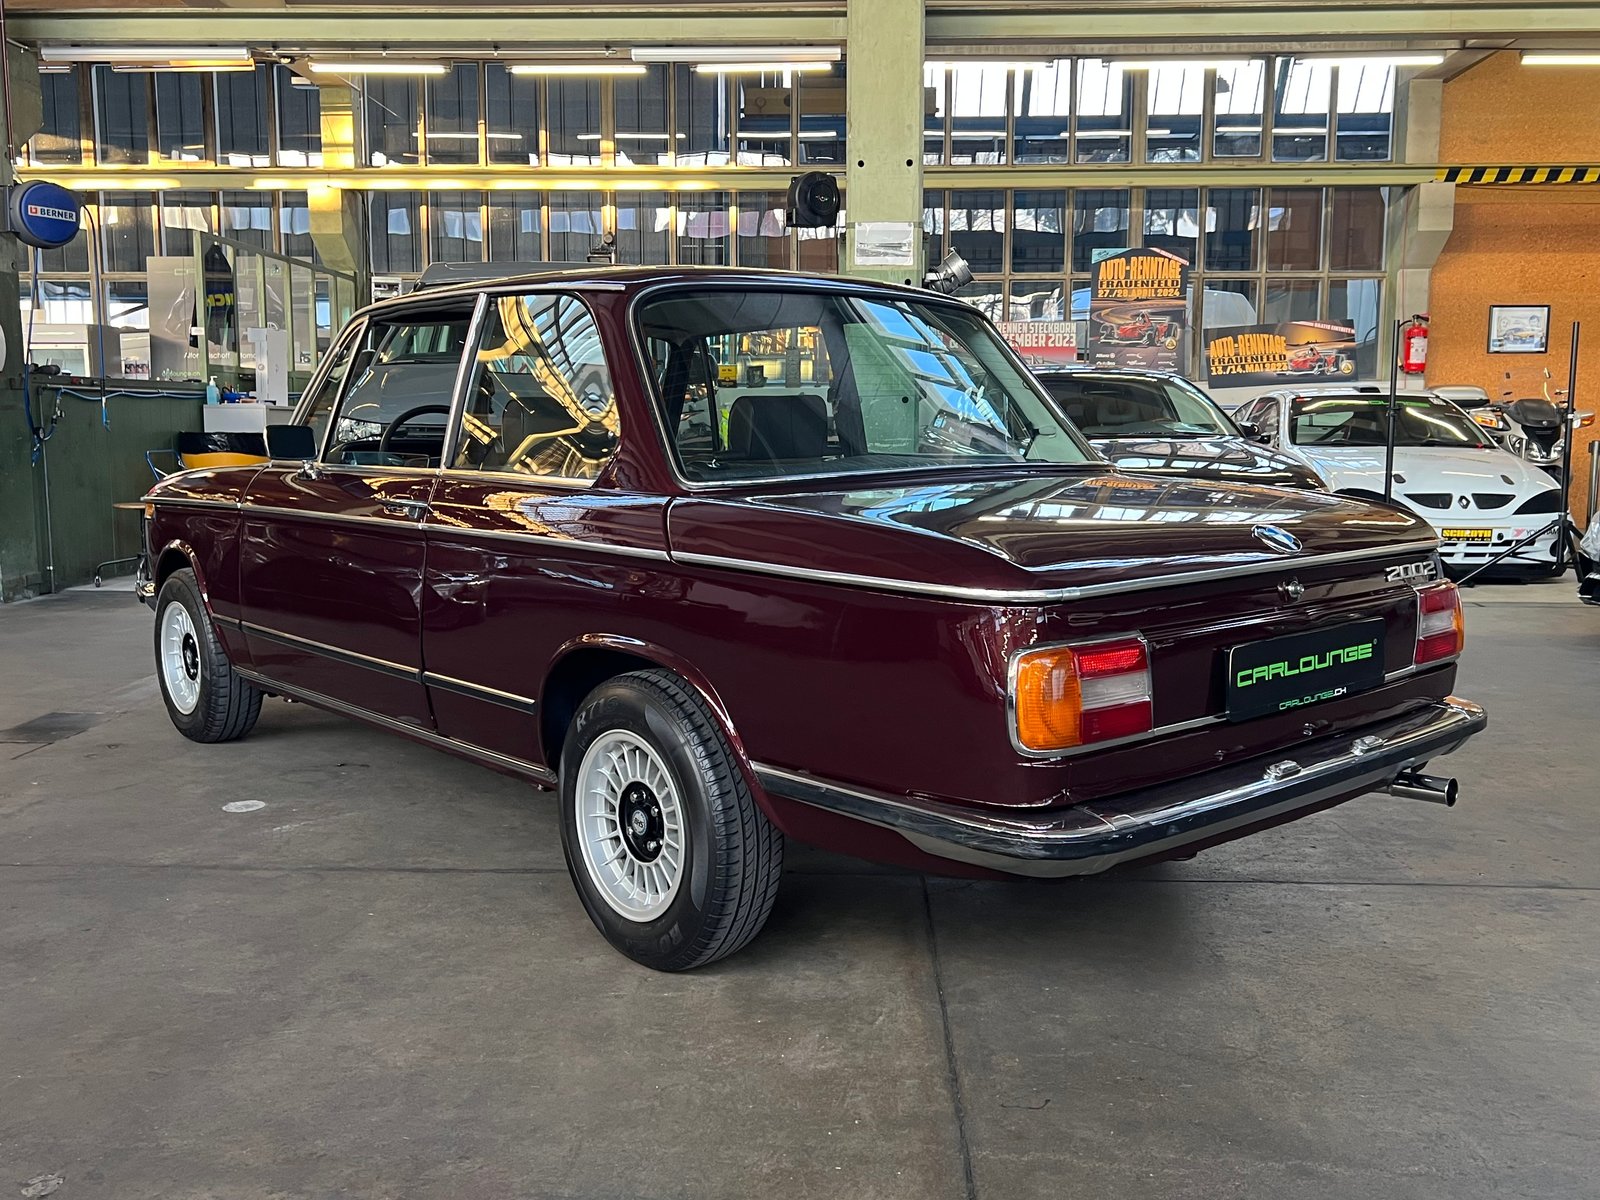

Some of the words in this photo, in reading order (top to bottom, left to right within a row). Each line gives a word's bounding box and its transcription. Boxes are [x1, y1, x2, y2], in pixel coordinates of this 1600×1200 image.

[40, 207, 75, 221] BERNER
[1099, 256, 1182, 280] AUTO-RENNTAGE
[1099, 279, 1180, 289] FRAUENFELD
[1157, 288, 1180, 297] 2024
[1029, 322, 1077, 334] STECKBORN
[1047, 334, 1077, 347] 2023
[1210, 333, 1287, 358] AUTO-RENNTAGE
[1211, 354, 1287, 365] FRAUENFELD
[1442, 529, 1492, 538] SCHROTH
[1384, 560, 1437, 582] 2002
